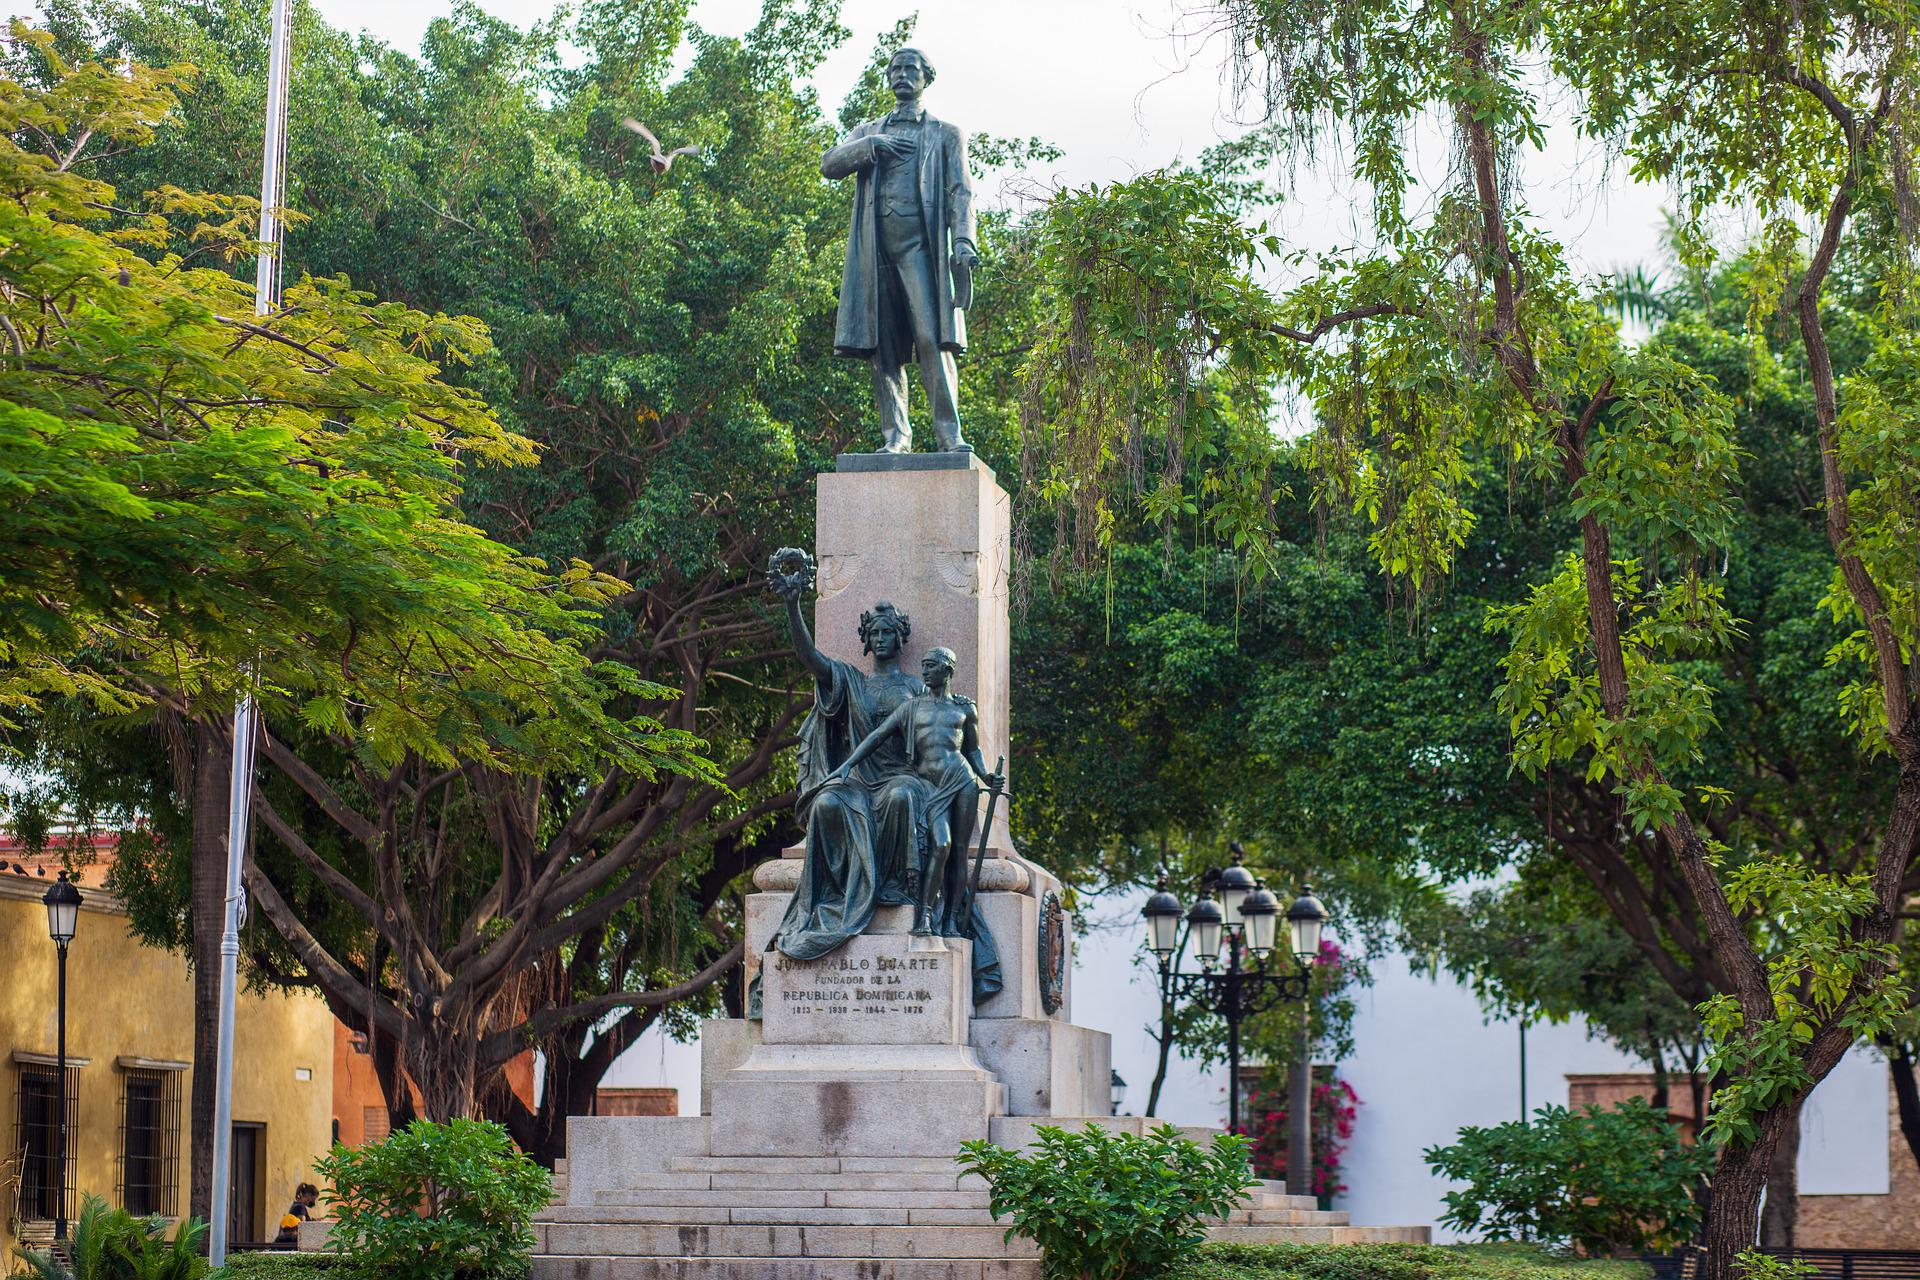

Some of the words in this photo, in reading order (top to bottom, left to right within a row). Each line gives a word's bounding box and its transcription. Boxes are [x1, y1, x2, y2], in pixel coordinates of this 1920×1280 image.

[775, 959, 812, 971] JUAN
[821, 959, 869, 970] PABLO
[877, 958, 938, 971] DUARTE
[815, 976, 864, 985] FUNDADOR
[870, 976, 882, 985] DE
[887, 975, 901, 985] LA
[783, 990, 849, 1001] REPUBLICA
[856, 990, 931, 1001] DOMINICANA
